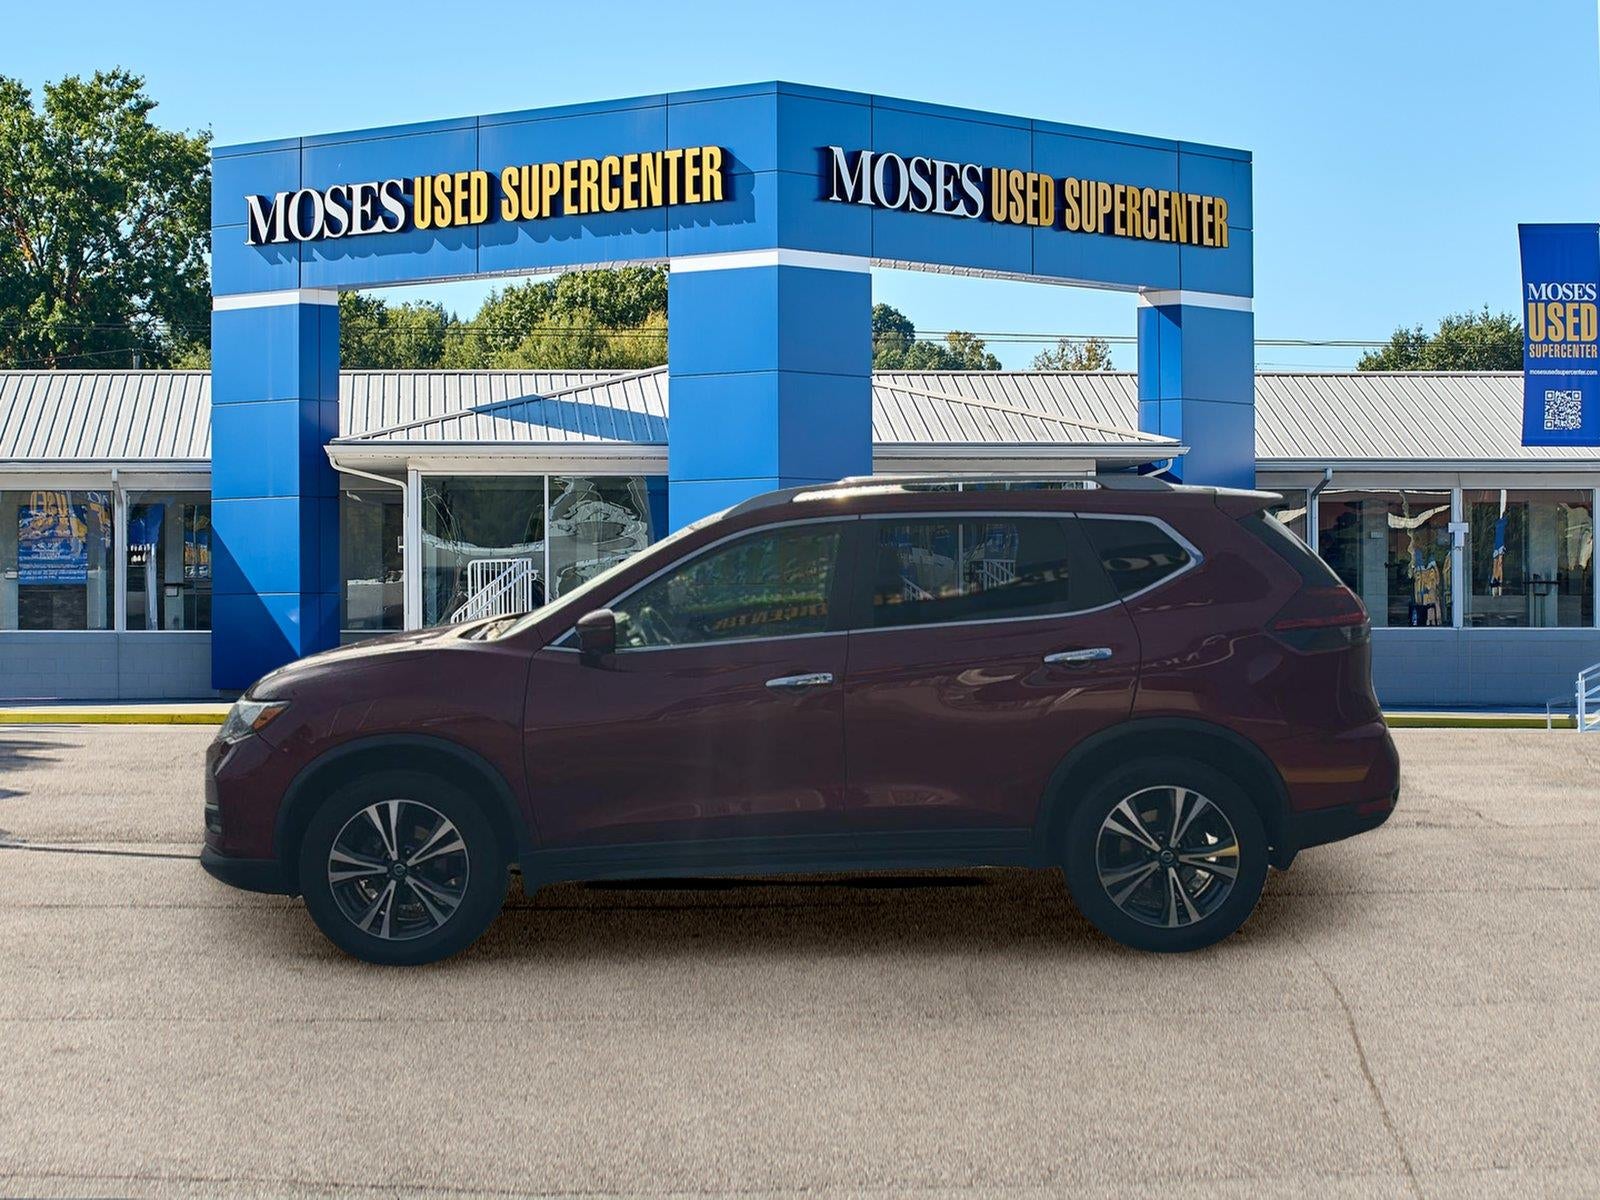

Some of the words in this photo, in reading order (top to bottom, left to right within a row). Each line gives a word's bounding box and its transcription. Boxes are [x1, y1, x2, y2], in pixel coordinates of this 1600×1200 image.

[244, 178, 407, 246] MOSES
[413, 170, 489, 230] USED
[501, 145, 723, 222] SUPERCENTER
[828, 145, 984, 219] MOSES
[991, 167, 1055, 227] USED
[1064, 176, 1229, 248] SUPERCENTER
[1527, 283, 1597, 301] MOSES
[1527, 302, 1598, 342] USED
[1529, 344, 1598, 358] SUPERCENTER
[1529, 369, 1598, 377] mosesusedsupercenter.com
